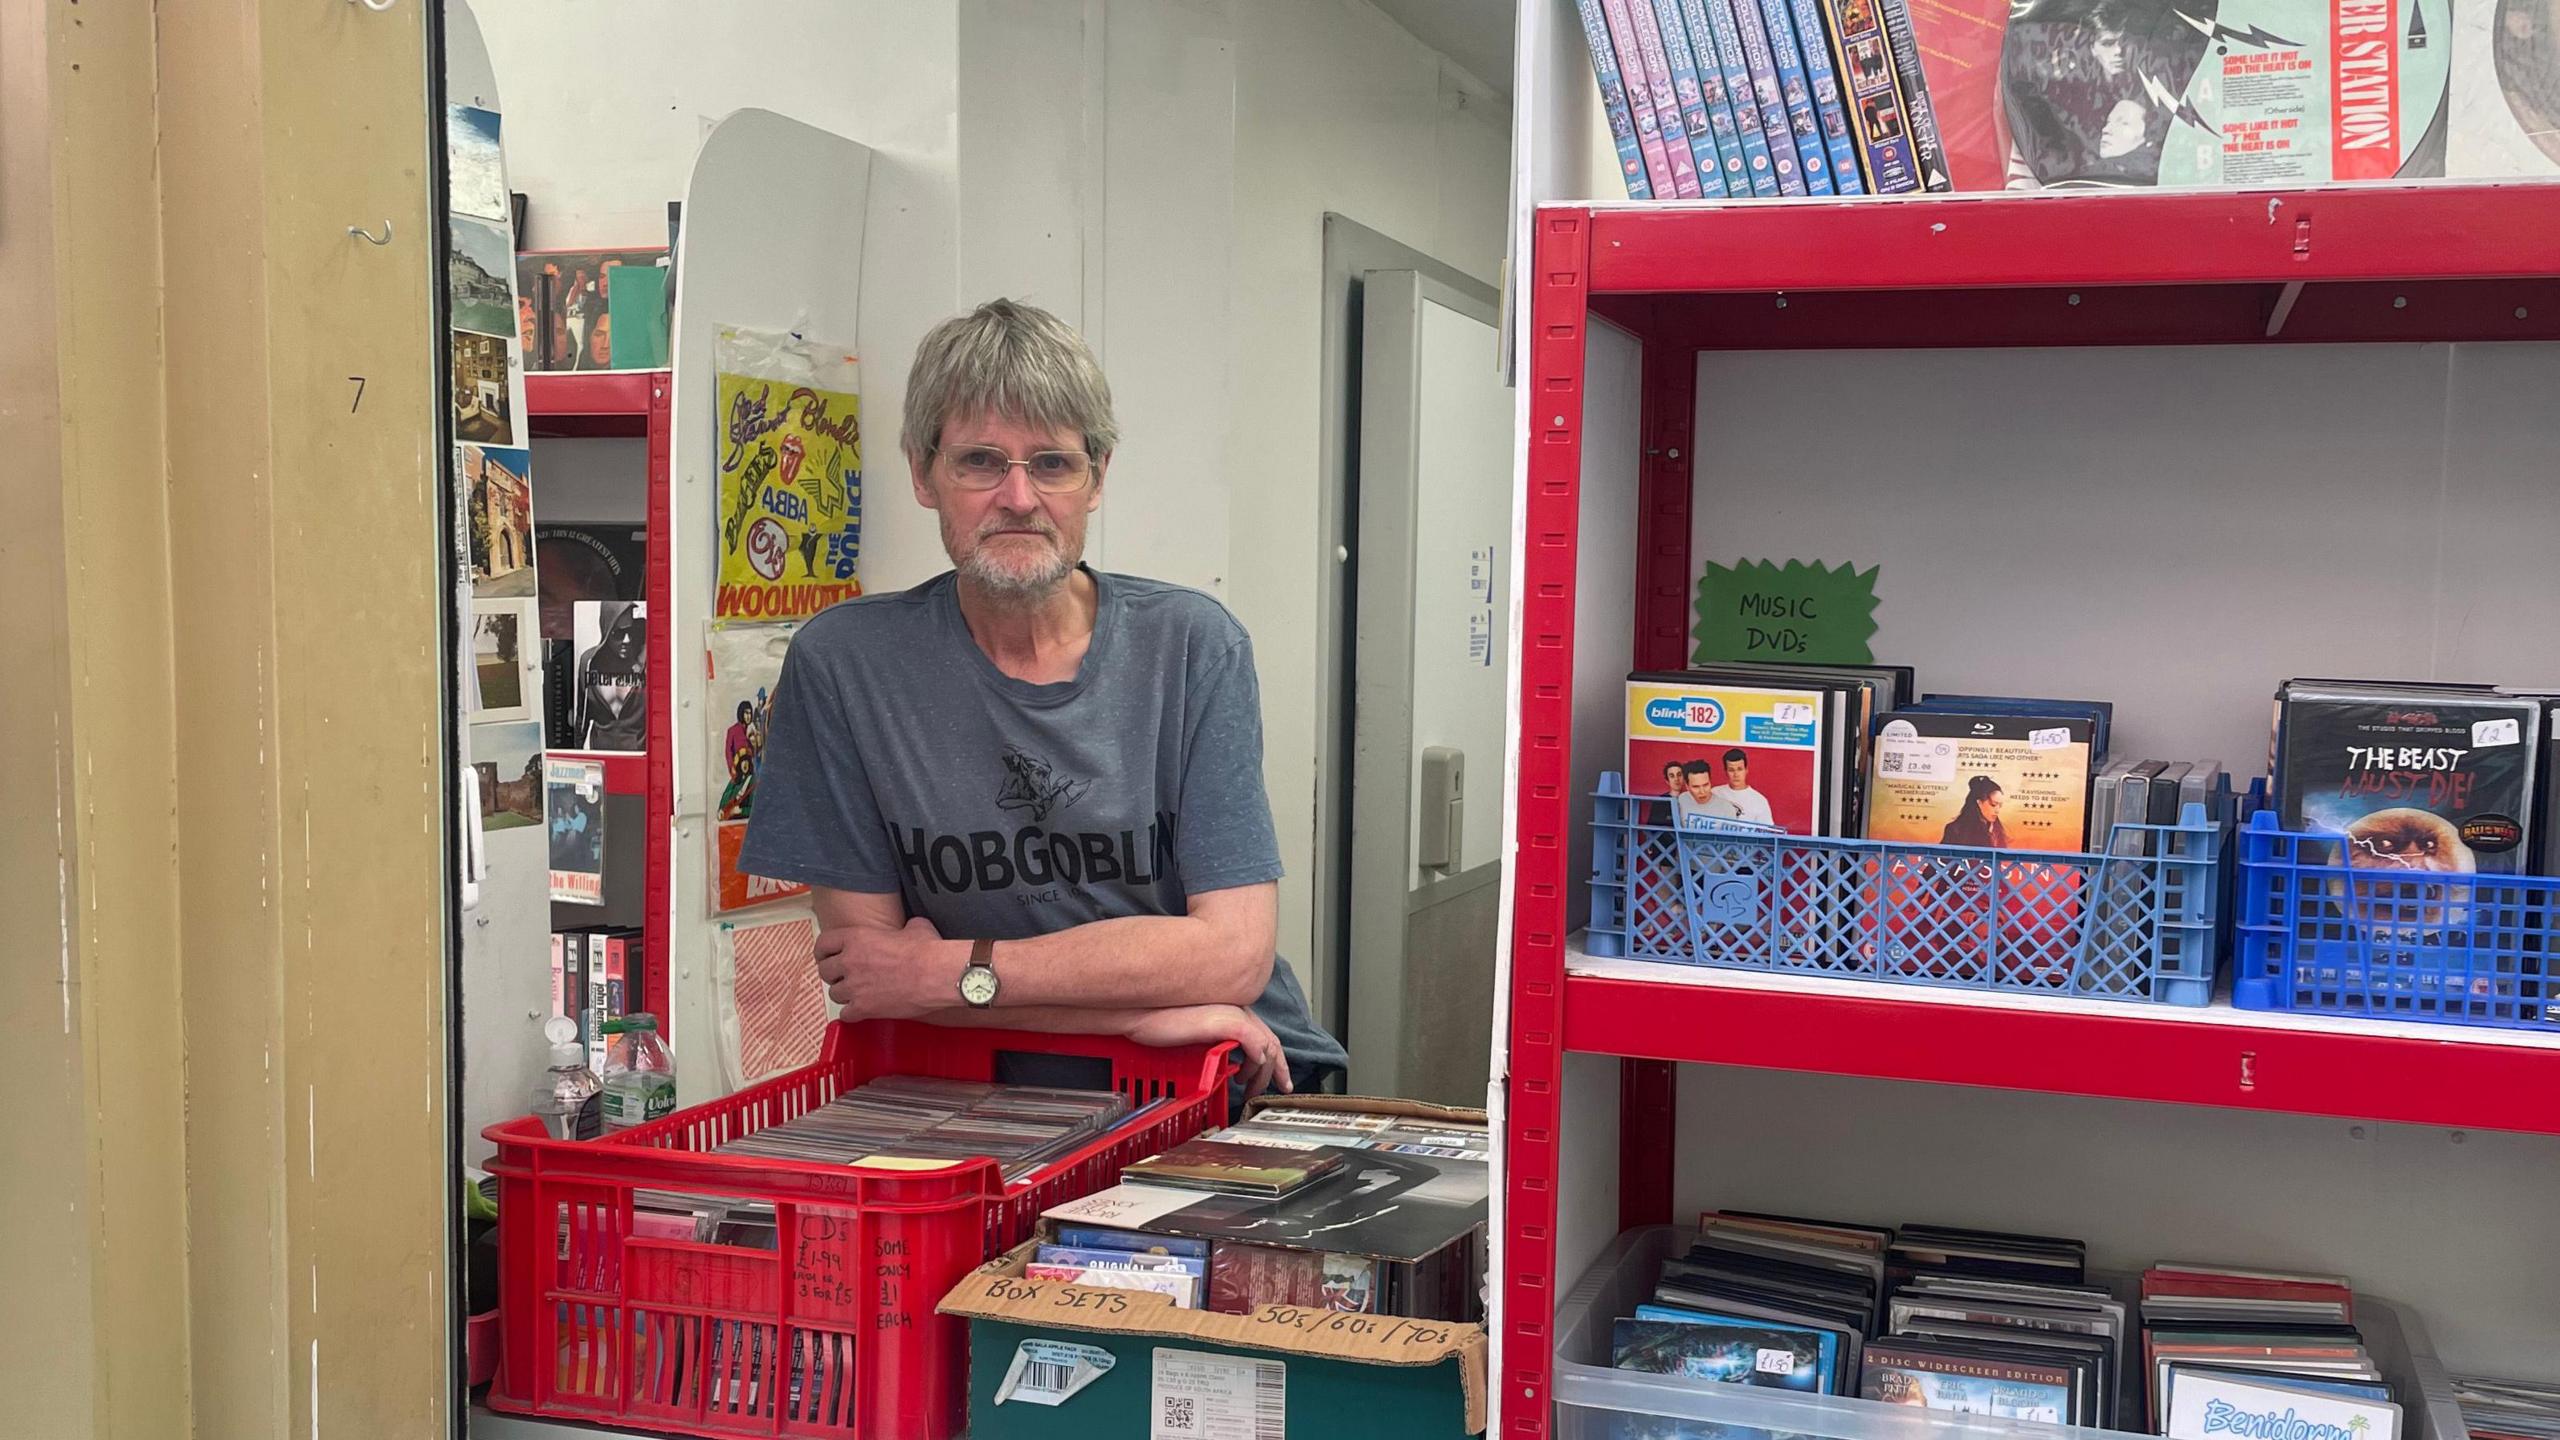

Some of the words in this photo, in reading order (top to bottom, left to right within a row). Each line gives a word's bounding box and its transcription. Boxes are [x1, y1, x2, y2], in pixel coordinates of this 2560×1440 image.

[1582, 0, 1608, 74] COLLECTION
[1612, 0, 1639, 75] COLLECTION
[1712, 0, 1737, 68] OLLECTION
[1731, 32, 1745, 65] FILMS
[1765, 0, 1791, 69] OLLECTION
[1600, 35, 1616, 71] FILMS
[1704, 35, 1719, 67] FILMS
[1784, 35, 1798, 67] FILMS
[1816, 36, 1830, 69] FILMS
[2223, 55, 2248, 65] SOME
[2250, 53, 2268, 63] LIKE
[2271, 52, 2278, 62] IT
[2281, 51, 2298, 60] HOT
[2223, 65, 2242, 75] AND
[2244, 64, 2261, 74] THE
[2263, 62, 2285, 72] HEAT
[2288, 61, 2296, 70] IS
[2298, 60, 2312, 70] ON
[2339, 41, 2390, 149] STATION
[1905, 100, 1934, 162] MONSTER
[2223, 122, 2248, 133] SOME
[2250, 121, 2268, 131] LIKE
[2271, 120, 2278, 129] IT
[2281, 119, 2298, 128] HOT
[2243, 132, 2261, 141] MIX
[2223, 143, 2239, 152] THE
[2241, 141, 2264, 151] HEAT
[2266, 140, 2274, 149] IS
[2276, 139, 2290, 149] ON
[348, 376, 365, 413] 7
[762, 485, 808, 525] ABBA
[835, 468, 862, 580] POLICE
[576, 533, 610, 561] GREATEST
[607, 555, 622, 576] HITS
[825, 532, 841, 567] THE
[1740, 593, 1818, 620] MUSIC
[1886, 731, 1913, 739] LIMITED
[1958, 746, 1992, 754] OPPINGLY
[1971, 753, 1988, 761] SAGA
[2346, 746, 2395, 770] THE
[2397, 747, 2469, 771] BEAST
[2339, 771, 2429, 800] MUST
[2429, 771, 2478, 810] DIE!
[890, 811, 1178, 894] HOBGOBLIN
[1016, 889, 1061, 906] SINCE
[597, 983, 608, 1006] john
[874, 1236, 911, 1258] SOME
[876, 1264, 912, 1281] ONLY
[798, 1284, 809, 1298] 3
[813, 1287, 832, 1301] FOR
[986, 1278, 1044, 1302] BOX
[1055, 1285, 1129, 1314] SETS
[875, 1312, 913, 1330] EACH
[1881, 1357, 1911, 1367] DISC
[1918, 1361, 1999, 1377] WIDESCREEN
[2006, 1370, 2064, 1384] EDITION
[1881, 1373, 1913, 1386] BRAD
[2203, 1398, 2353, 1440] Benidorm
